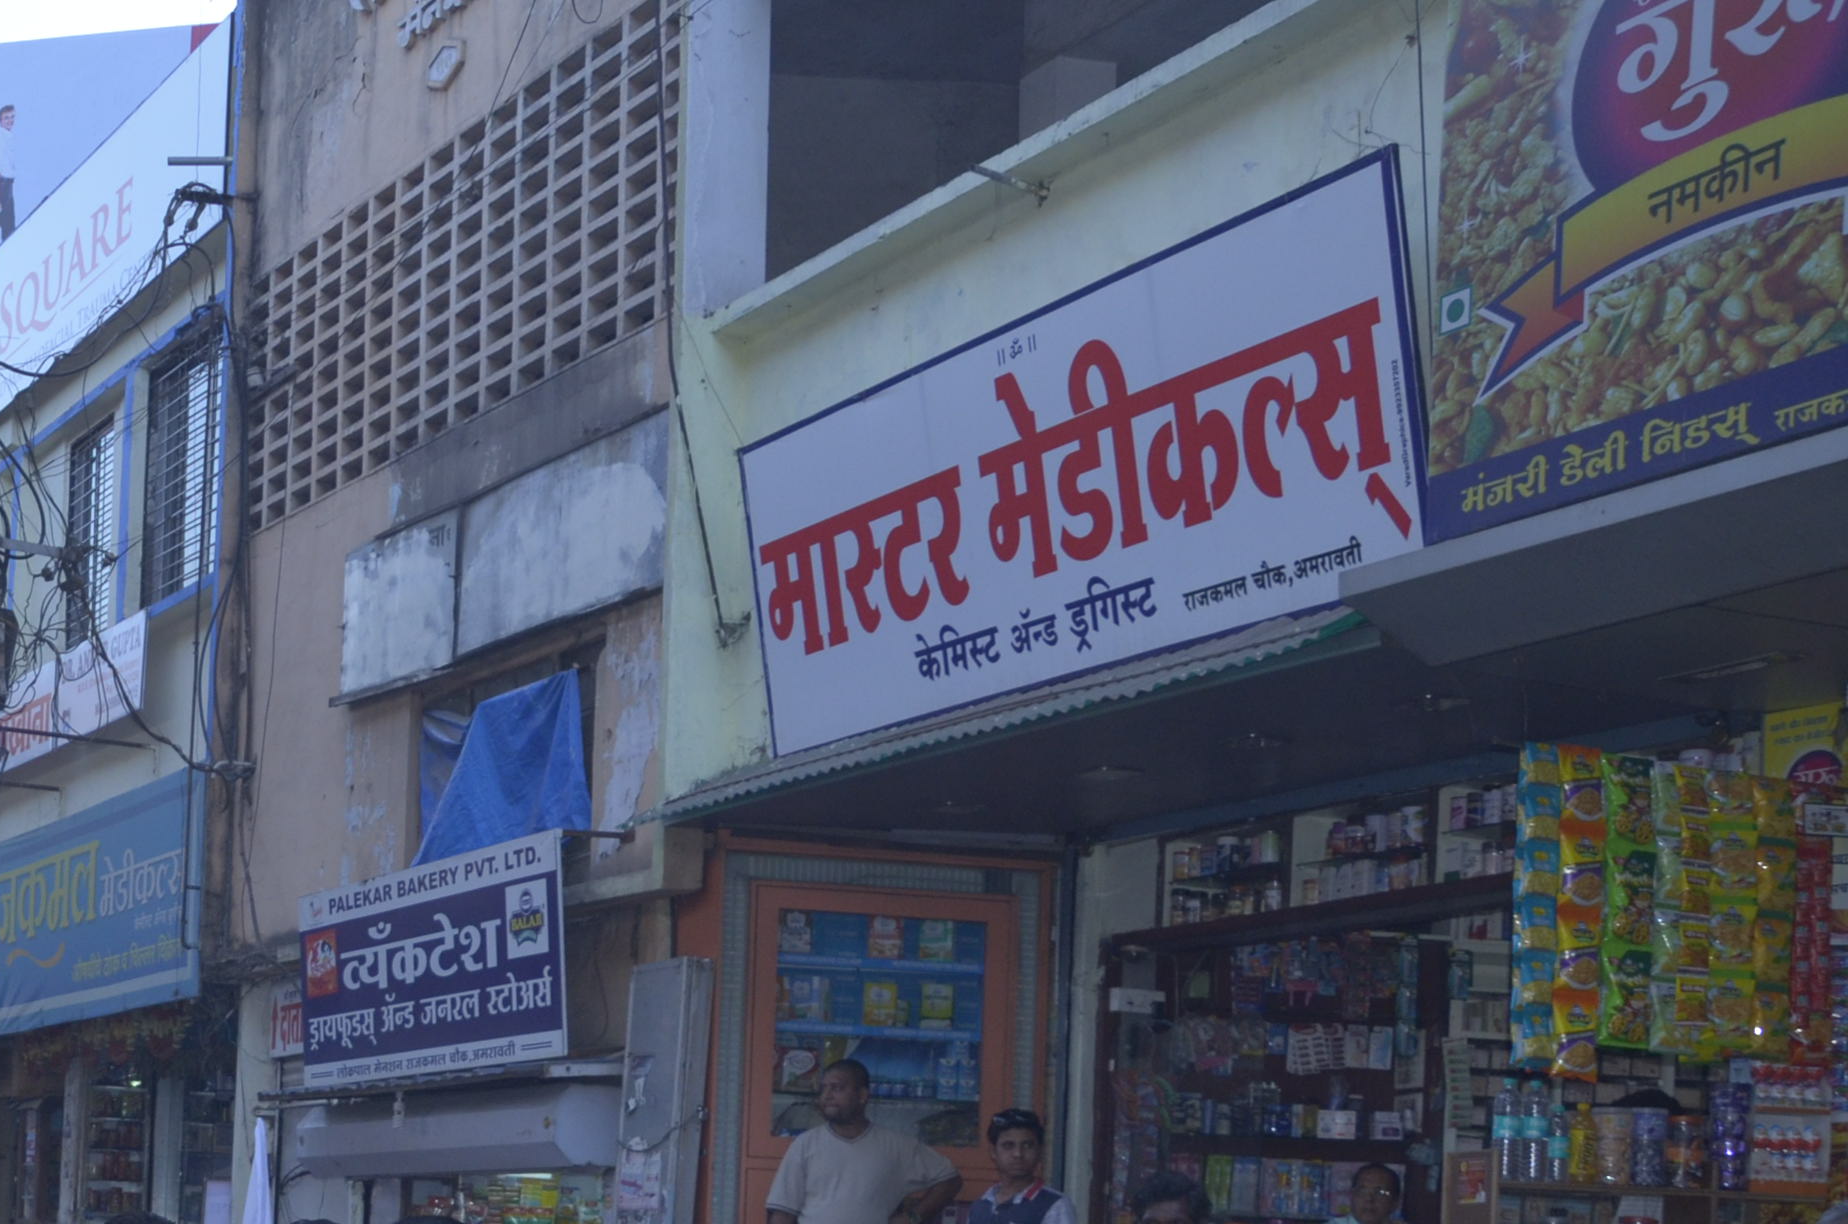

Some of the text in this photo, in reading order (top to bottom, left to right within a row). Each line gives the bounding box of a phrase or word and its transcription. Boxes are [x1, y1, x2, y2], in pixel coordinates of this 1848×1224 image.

[1648, 138, 1786, 224] नमकीन
[1461, 455, 1548, 515] मंजरी
[1559, 430, 1627, 487] डेली
[1774, 391, 1848, 431] राजक
[759, 465, 970, 657] मास्टर
[1182, 575, 1248, 613] राजकमल
[915, 621, 1002, 682] केमिस्ट
[1066, 575, 1158, 649] ड्रगिस्ट
[328, 846, 542, 916] PALEKAR BAKERY PVT. LTD.
[421, 988, 480, 1026] जनरल
[487, 965, 552, 1015] स्टोअर्स
[336, 1058, 371, 1079] लोकपाल
[405, 1052, 446, 1072] राजकमल
